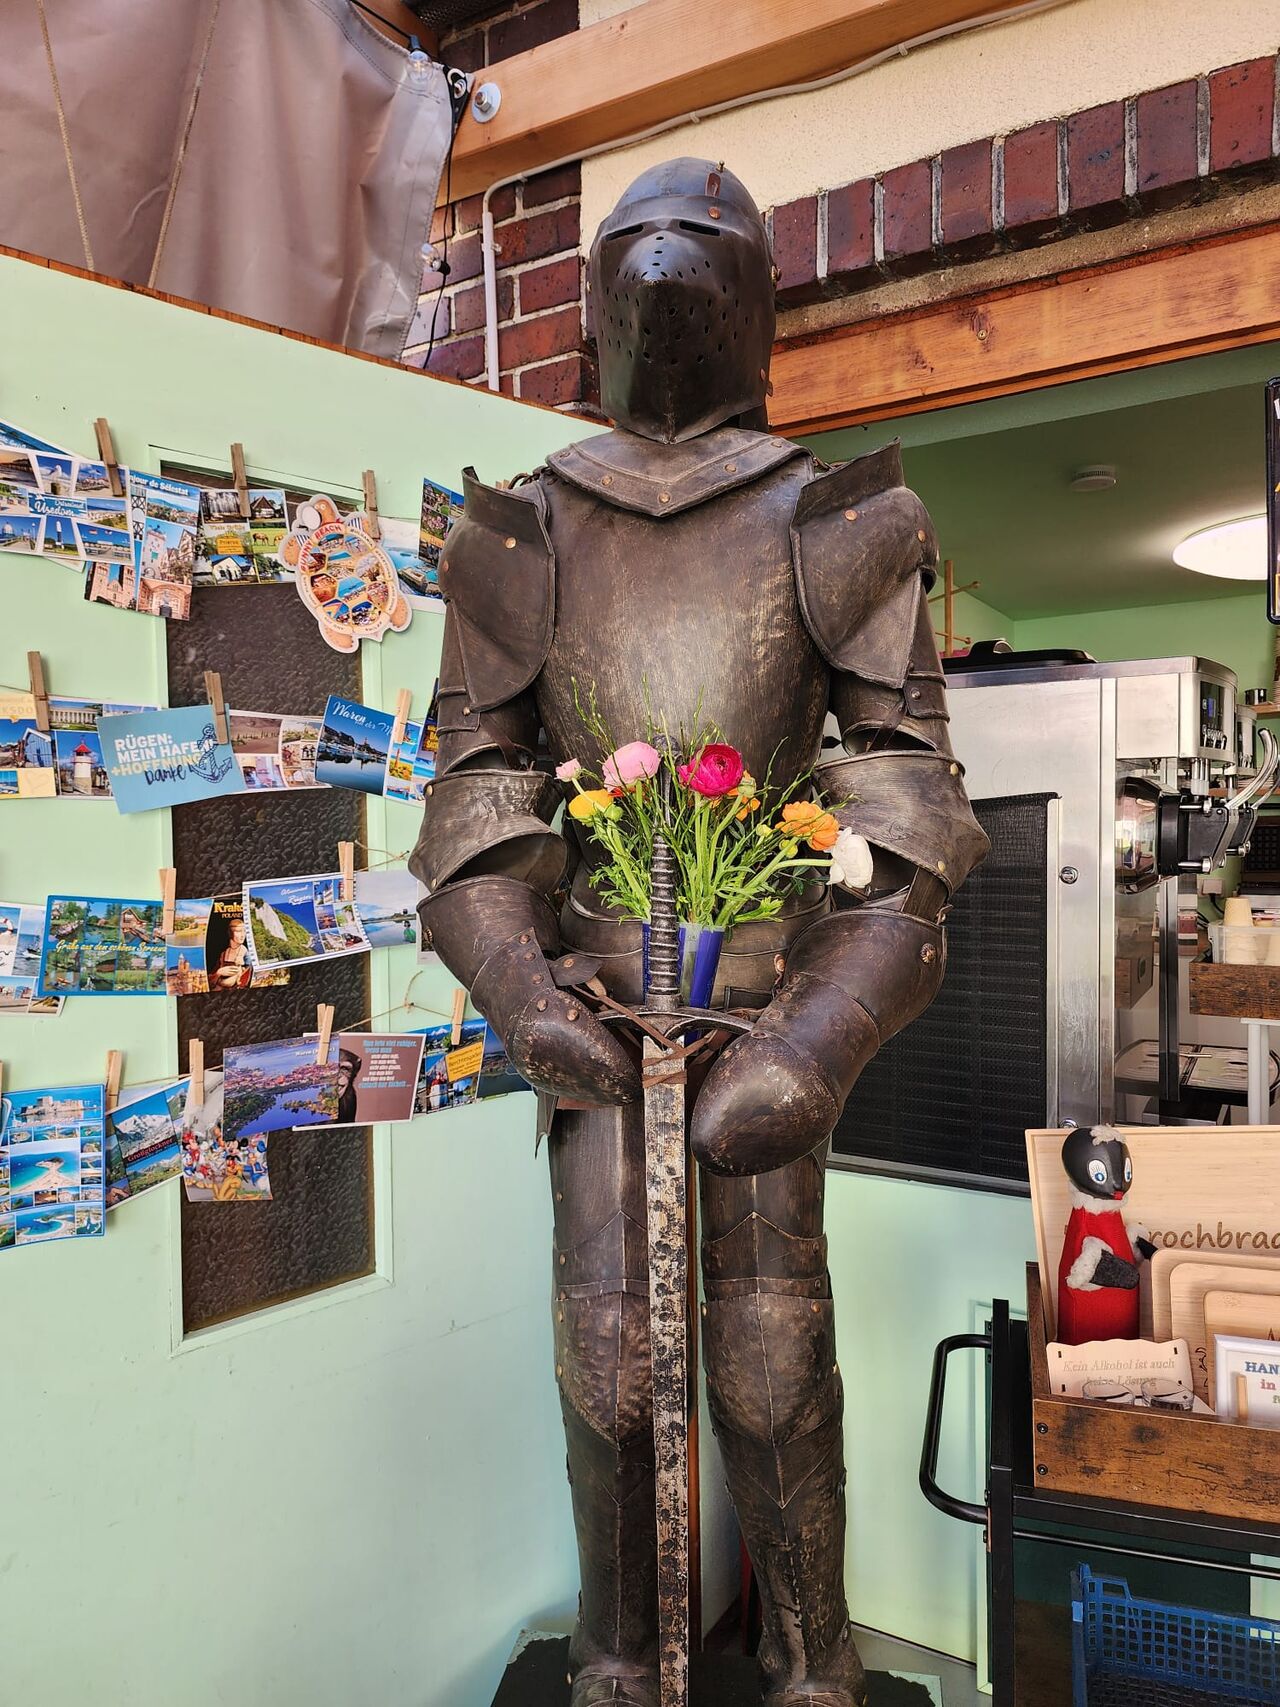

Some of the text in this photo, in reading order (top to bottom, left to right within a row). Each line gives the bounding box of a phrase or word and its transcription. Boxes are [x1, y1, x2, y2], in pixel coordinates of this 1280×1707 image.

[149, 480, 159, 488] de
[314, 525, 342, 540] BEACH
[333, 701, 366, 722] Waren
[114, 733, 173, 752] RÜGEN:
[117, 748, 157, 764] MEIN
[1091, 1359, 1132, 1371] Alkohol
[1135, 1359, 1147, 1369] ist
[1150, 1358, 1175, 1369] auch
[1260, 1379, 1276, 1390] in
